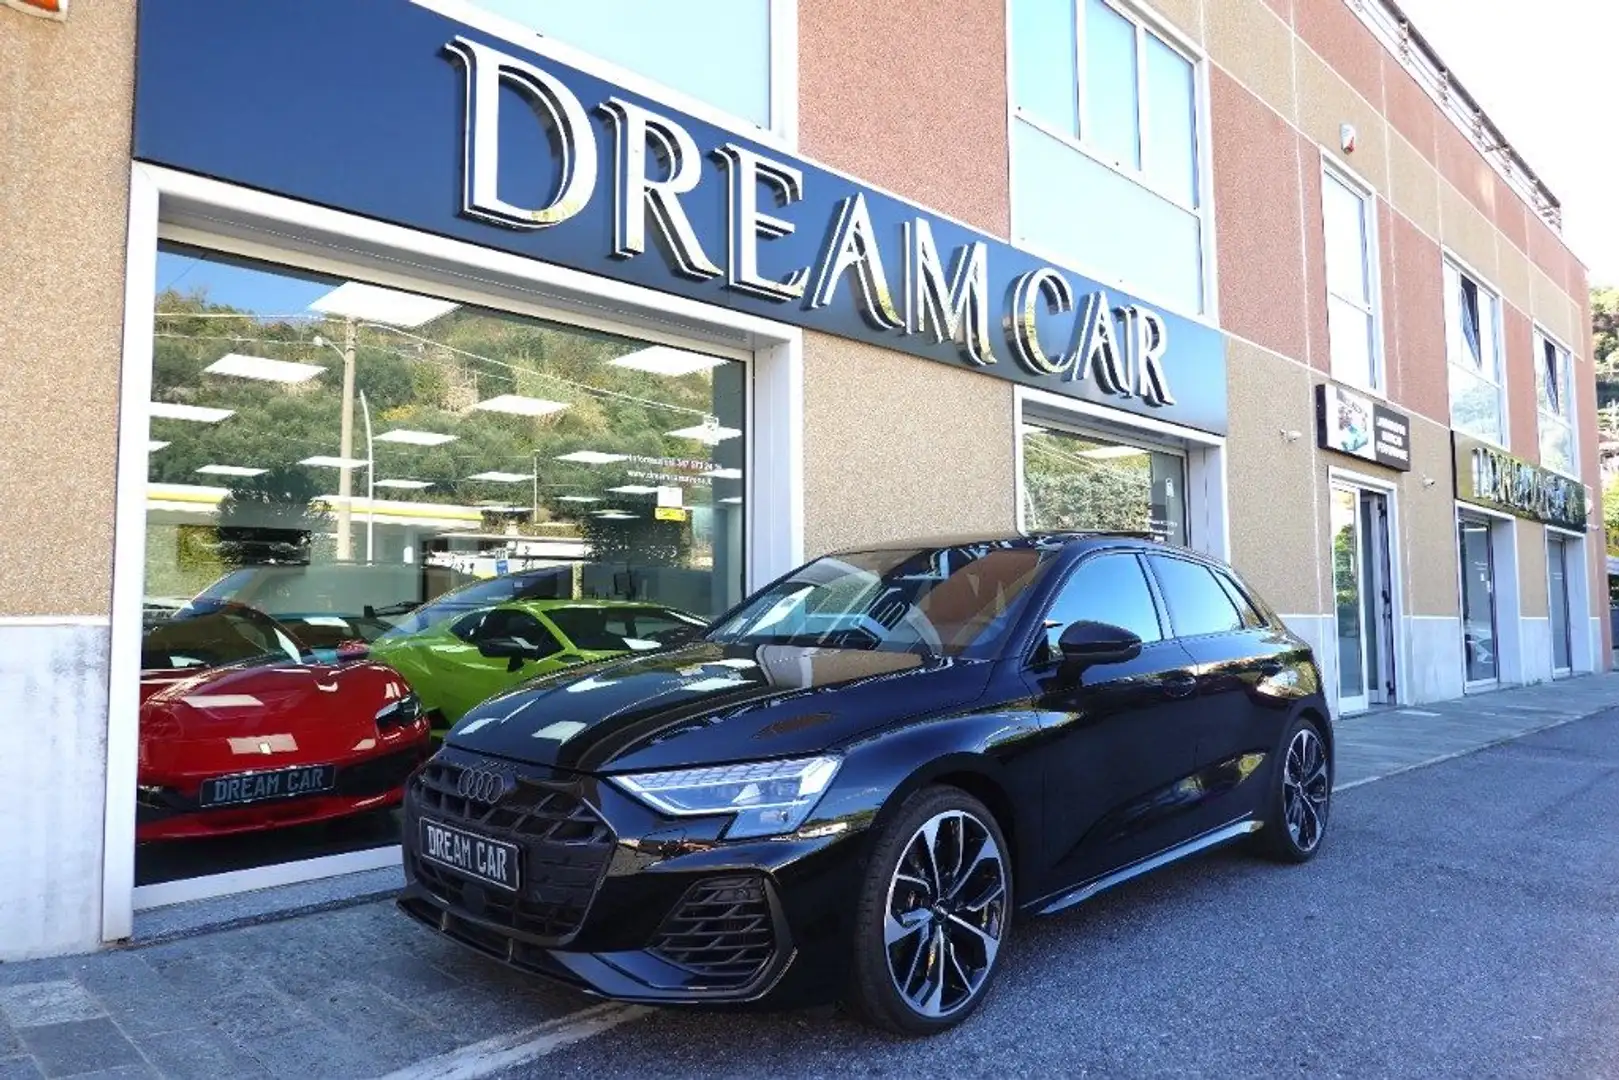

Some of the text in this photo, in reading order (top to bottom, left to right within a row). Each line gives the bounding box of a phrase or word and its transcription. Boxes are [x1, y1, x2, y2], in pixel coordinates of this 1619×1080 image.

[444, 34, 1176, 407] DREAM CAR
[213, 768, 324, 802] DREAM CAR
[427, 825, 507, 881] DREAM CAR
